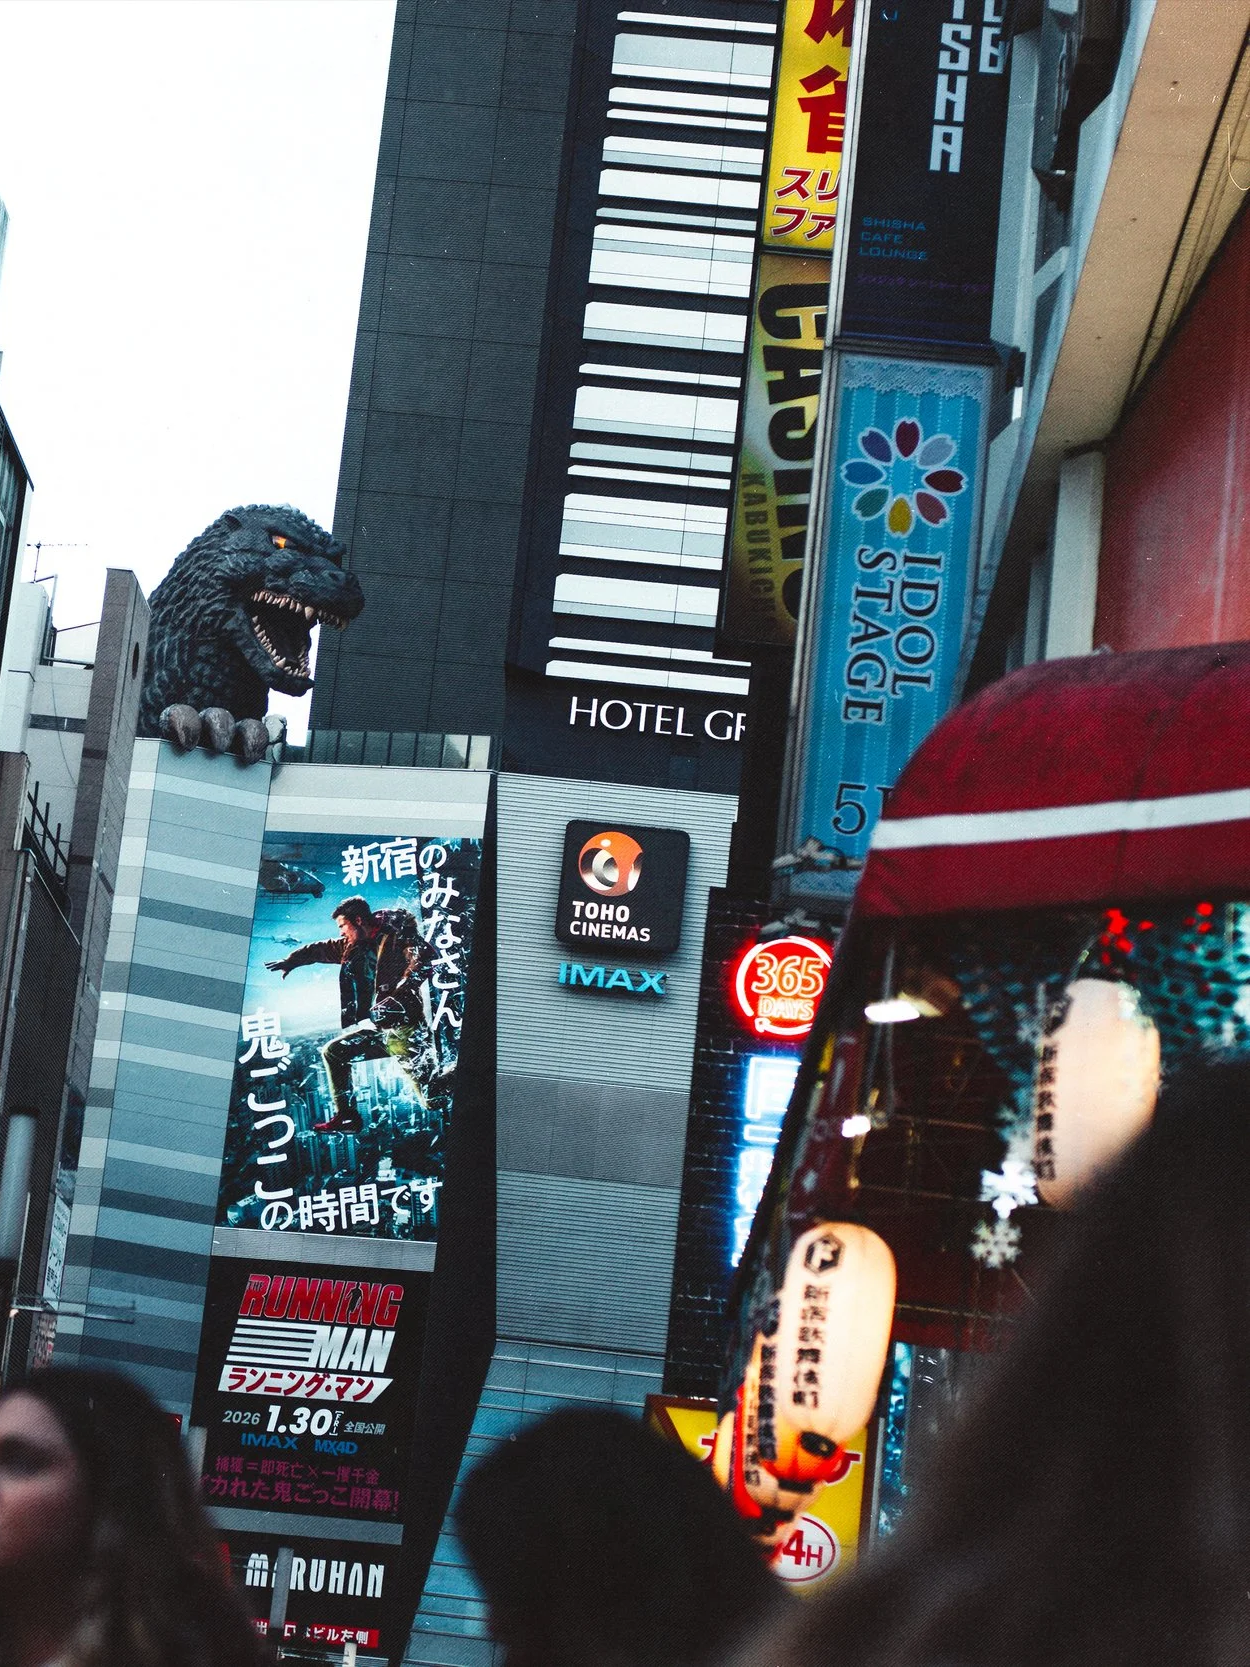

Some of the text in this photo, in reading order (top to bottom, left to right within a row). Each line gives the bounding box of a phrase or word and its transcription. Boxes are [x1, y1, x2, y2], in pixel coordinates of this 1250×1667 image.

[860, 231, 904, 244] CAFE
[842, 547, 897, 724] STAGE
[892, 552, 944, 696] IDOL
[569, 696, 694, 737] HOTEL
[831, 782, 893, 836] 5
[569, 921, 650, 942] CINEMAS
[572, 900, 630, 923] TOHO
[558, 961, 667, 995] IMAX
[751, 952, 825, 999] 365
[757, 995, 814, 1021] DAYS
[238, 1274, 404, 1327] RUNNING
[307, 1325, 396, 1373] MAN
[222, 1410, 261, 1425] 2026
[266, 1404, 333, 1437] 1.30
[343, 1421, 386, 1436] 全国公開
[241, 1432, 358, 1456] IMAX MX4D
[245, 1552, 385, 1598] MRUHAN
